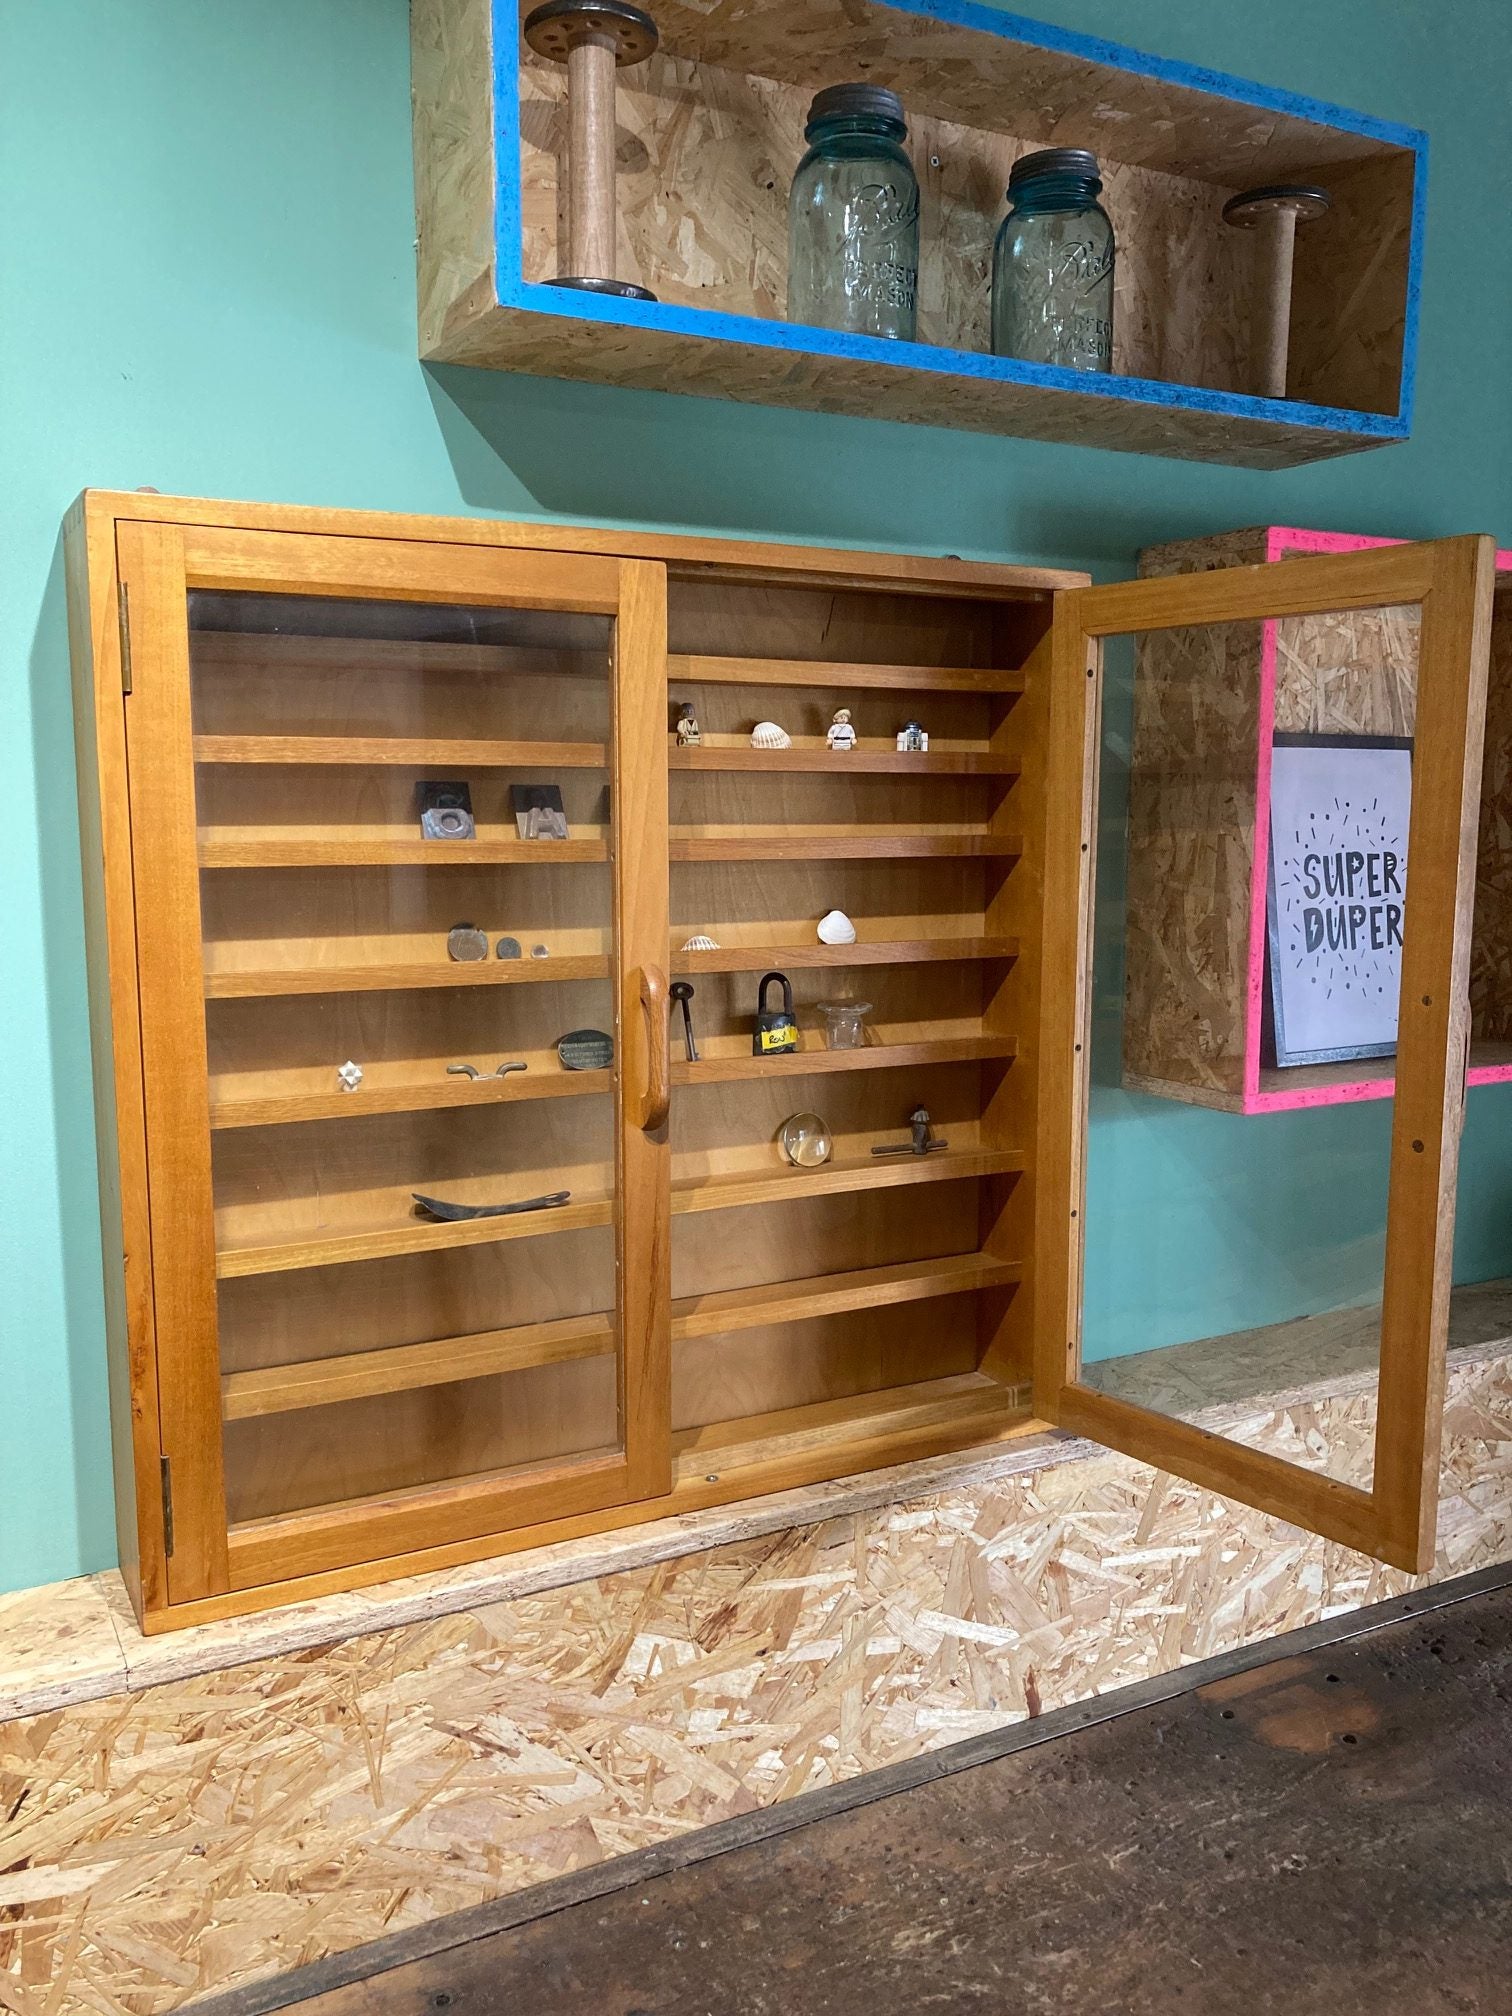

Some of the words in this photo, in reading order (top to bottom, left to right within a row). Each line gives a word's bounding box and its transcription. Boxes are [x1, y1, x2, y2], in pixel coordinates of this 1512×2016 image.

[852, 284, 914, 310] MASON
[1303, 851, 1402, 900] SUPER
[1303, 904, 1403, 954] DUPER
